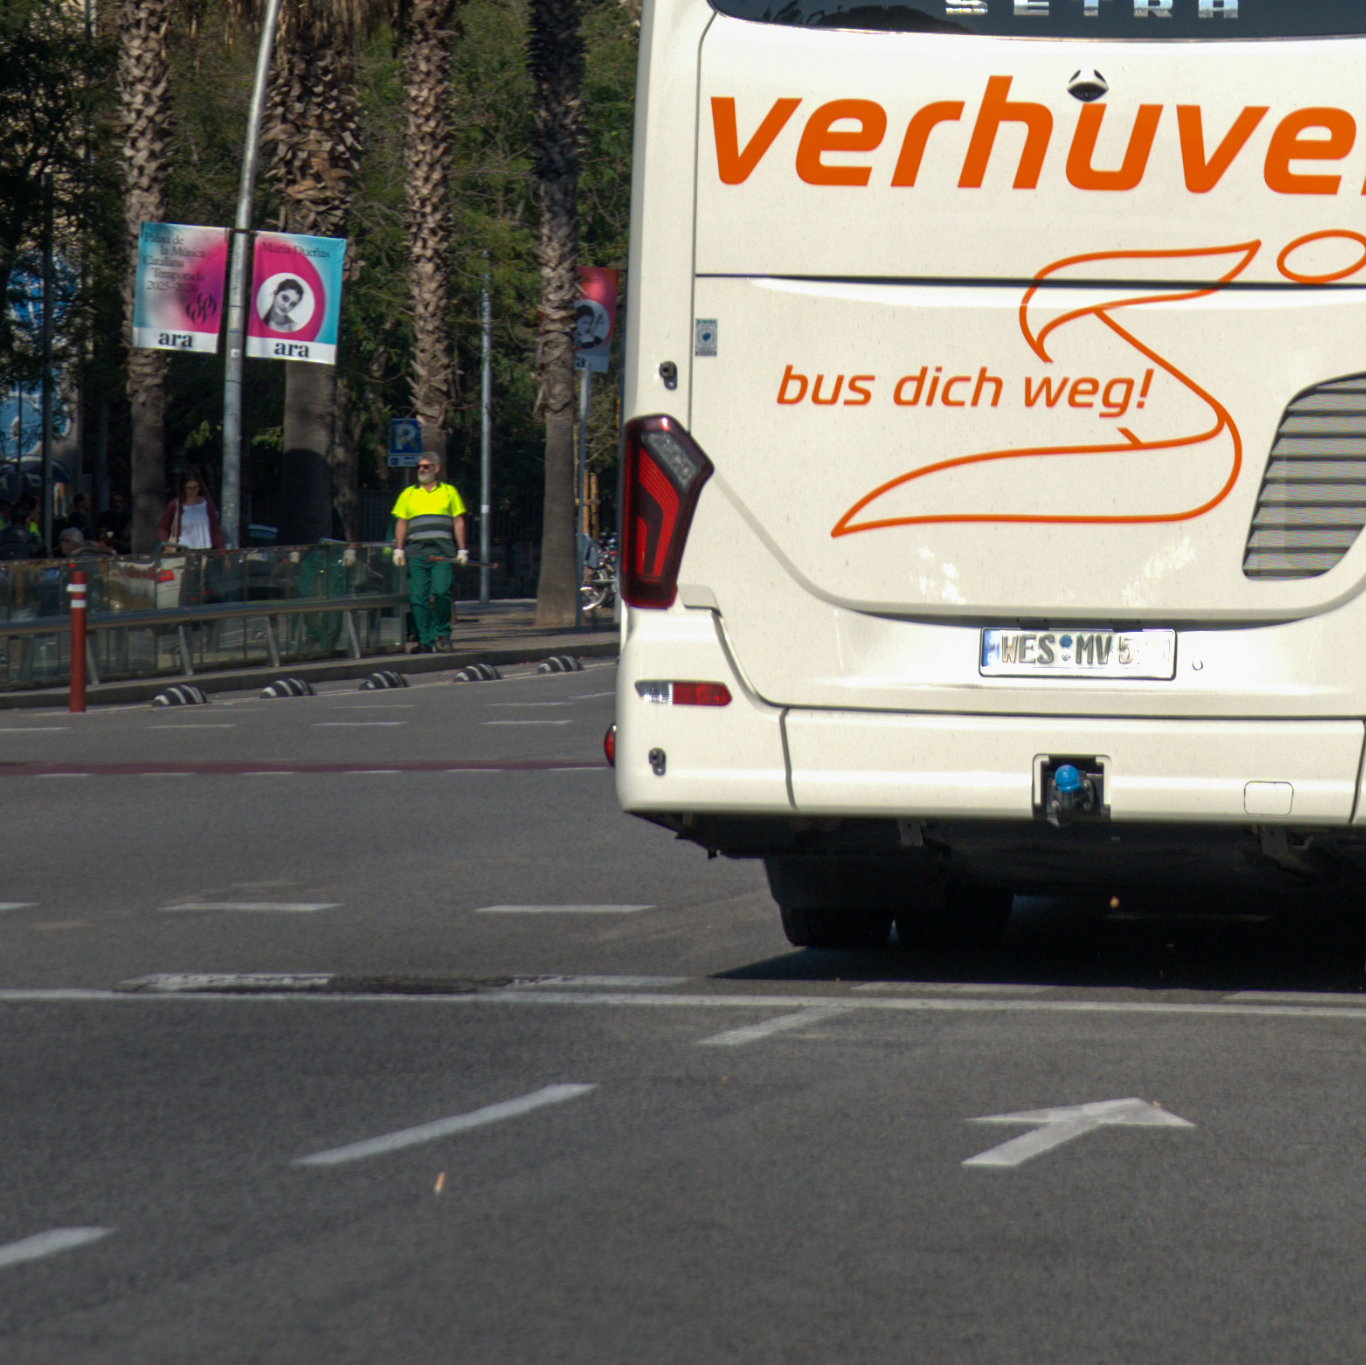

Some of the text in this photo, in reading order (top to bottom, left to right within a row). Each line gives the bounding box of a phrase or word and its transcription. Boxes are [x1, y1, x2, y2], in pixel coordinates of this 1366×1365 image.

[144, 231, 171, 244] Palau
[158, 331, 193, 348] ara
[273, 340, 311, 359] ara
[777, 364, 1155, 419] bus dich weg!
